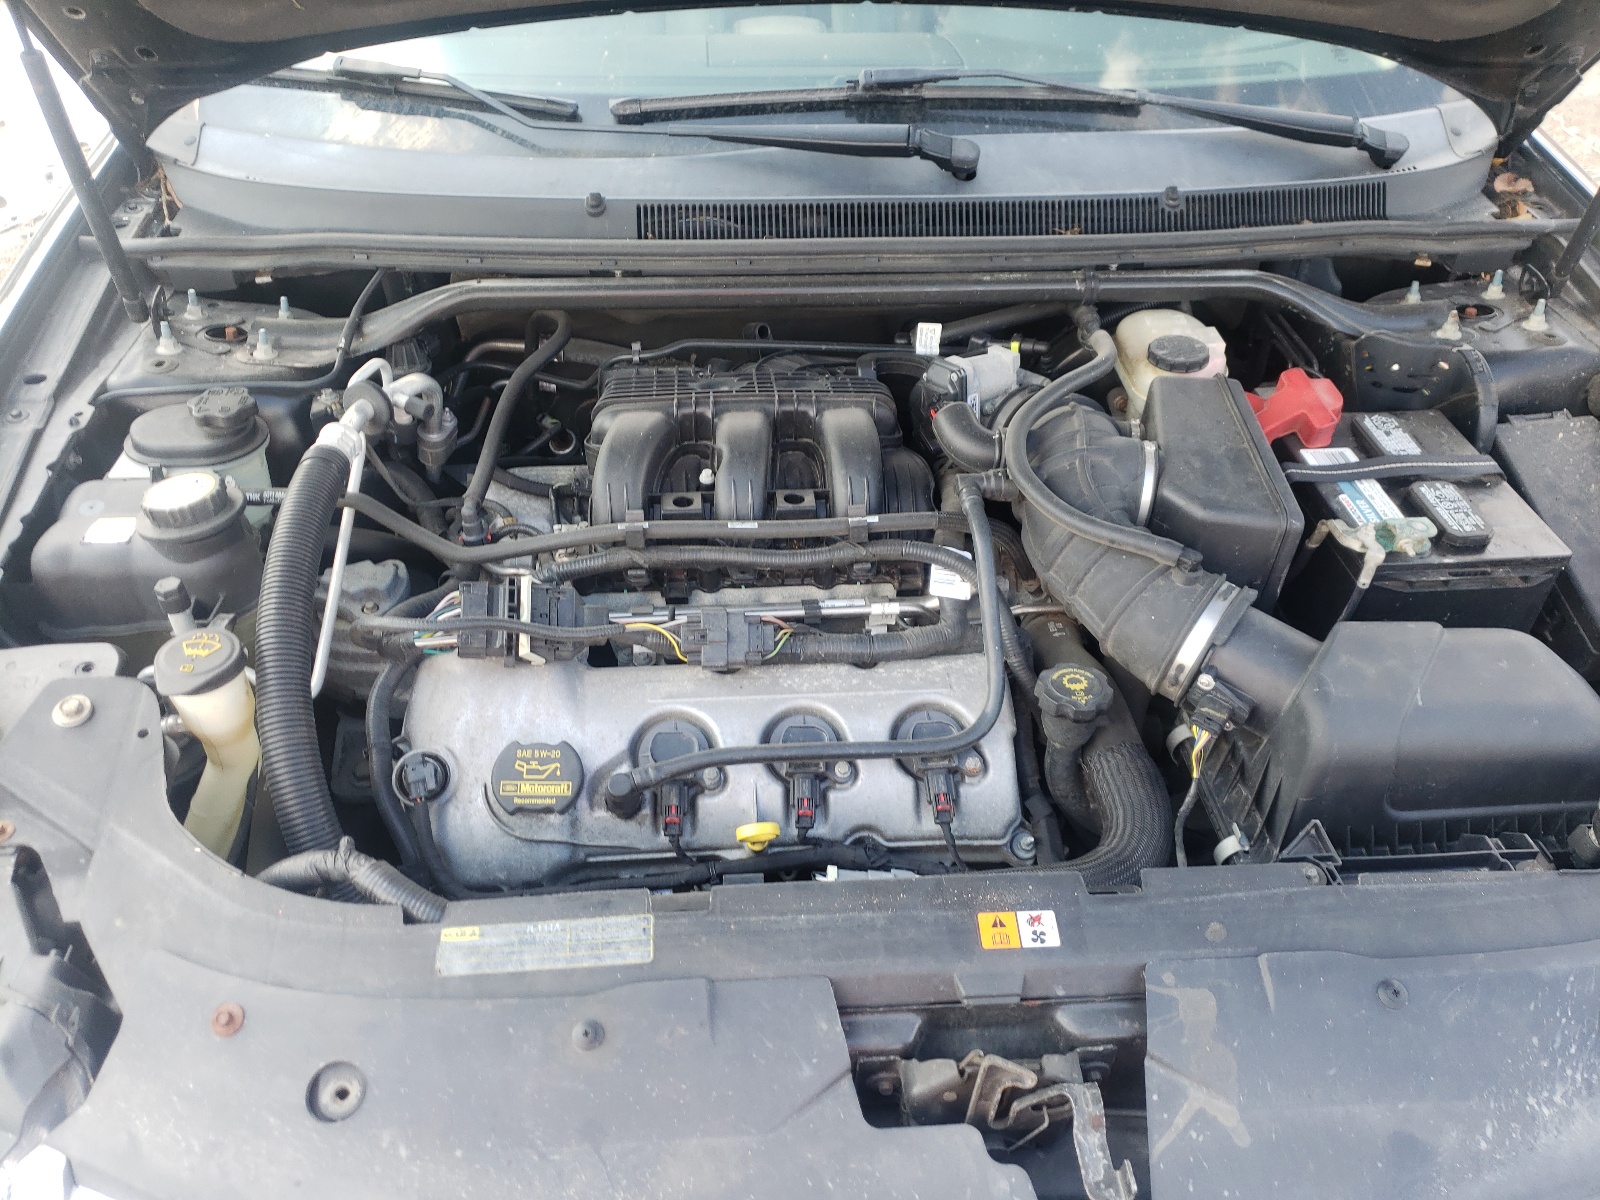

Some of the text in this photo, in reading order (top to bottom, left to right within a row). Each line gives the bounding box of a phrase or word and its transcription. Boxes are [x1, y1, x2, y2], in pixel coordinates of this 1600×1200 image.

[1355, 499, 1381, 523] SILVER
[516, 749, 561, 758] SAE 5W-20
[520, 782, 569, 794] Motorcraft
